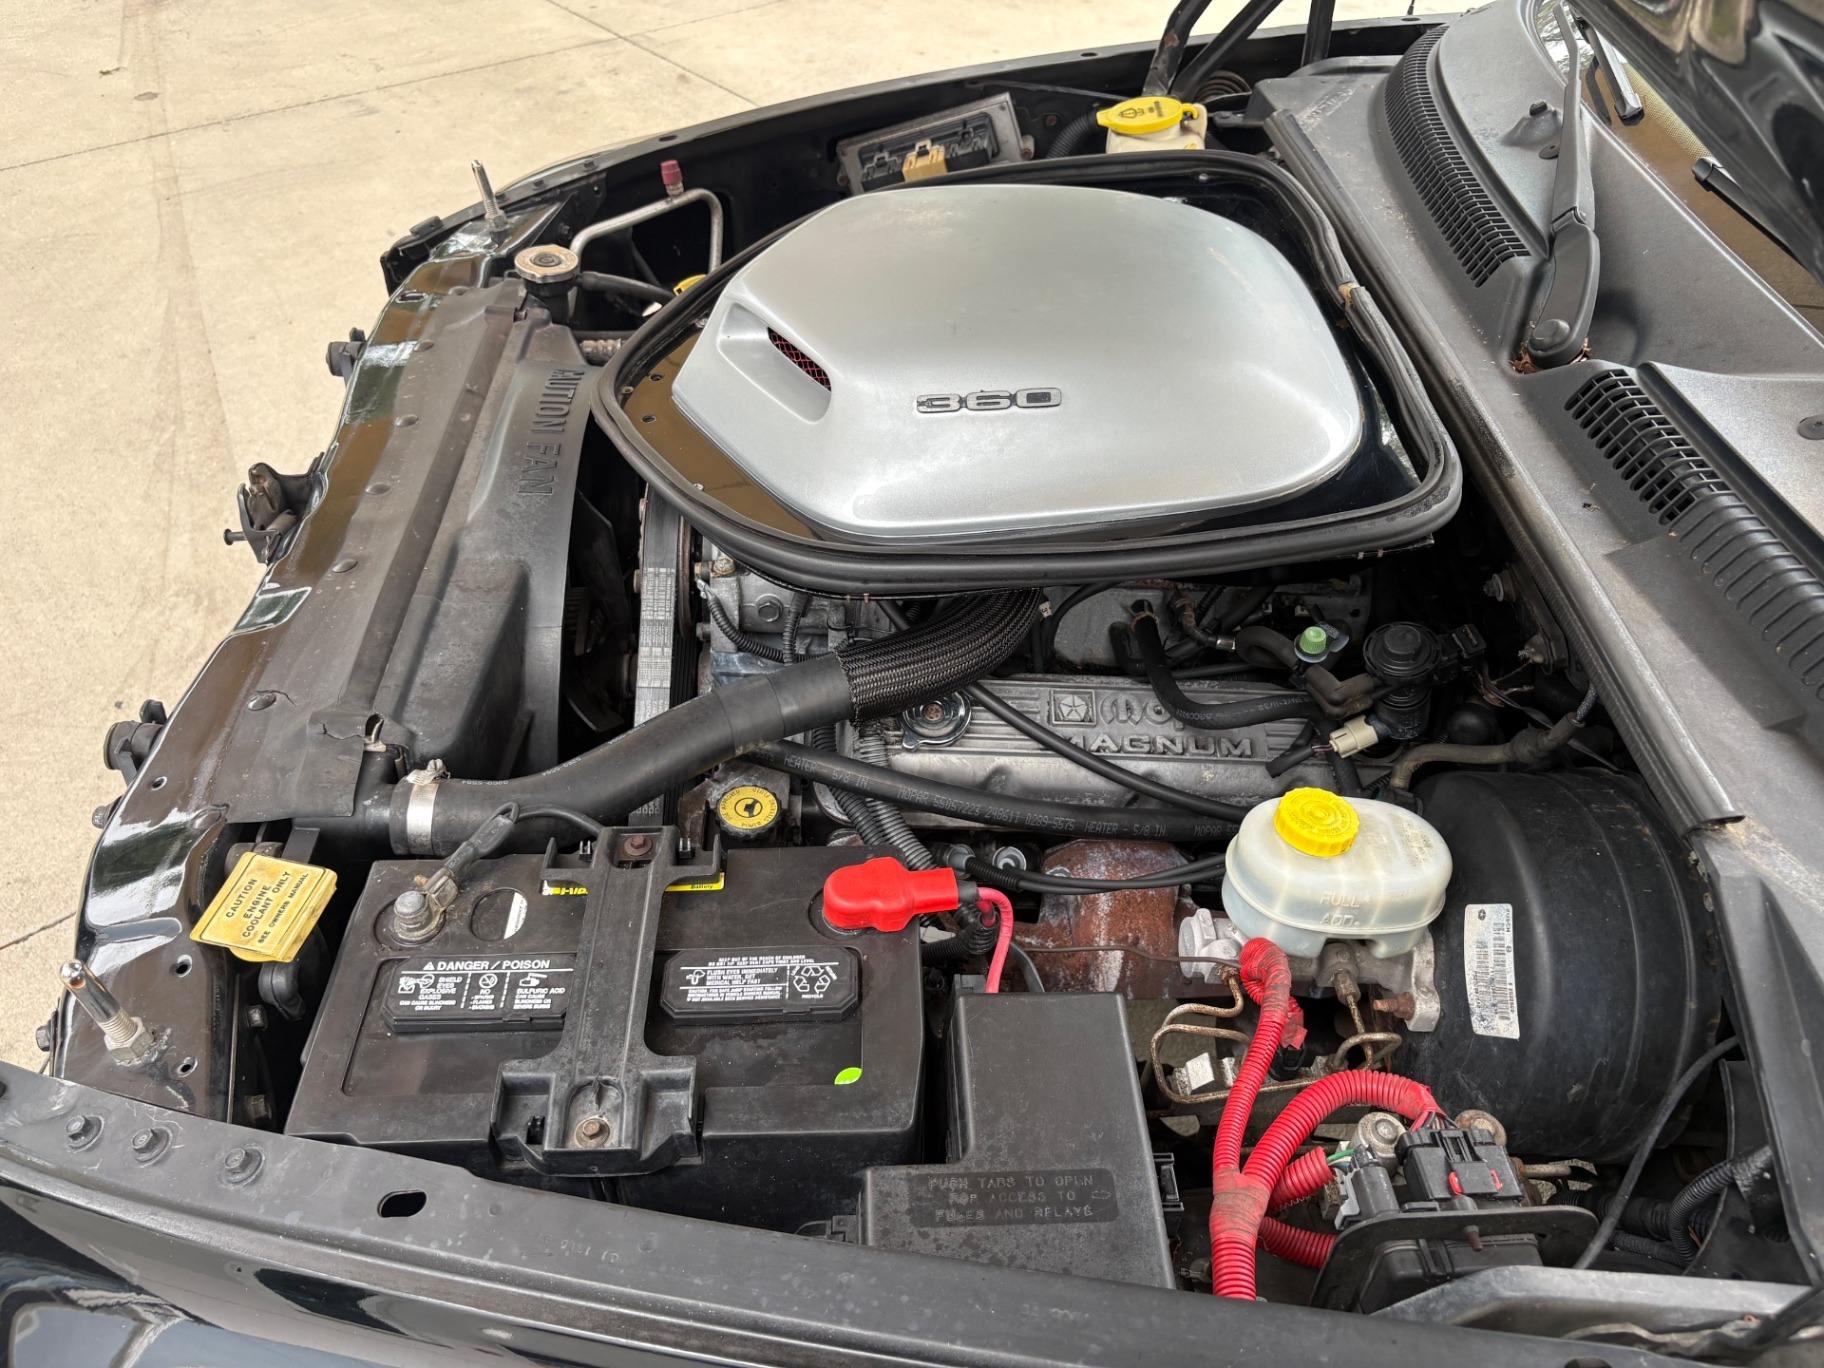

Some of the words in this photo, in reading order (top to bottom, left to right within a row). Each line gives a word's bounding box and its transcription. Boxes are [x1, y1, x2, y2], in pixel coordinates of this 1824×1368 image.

[531, 369, 585, 433] CAUTION
[916, 387, 1062, 413] 360
[518, 441, 561, 496] FAN
[784, 753, 817, 773] HEATER
[832, 769, 850, 782] 5/8
[897, 787, 929, 804] MOPAR
[933, 795, 981, 816] 55057223
[1024, 814, 1076, 831] 0289-5575
[1084, 822, 1118, 835] HEATER
[1133, 825, 1150, 836] 5/8
[226, 878, 257, 918] CAUTION
[242, 897, 273, 938] COOLANT
[271, 871, 291, 894] ONLY
[243, 884, 271, 919] ENGINE
[257, 930, 271, 944] SEE
[269, 900, 290, 928] OWNERS
[289, 872, 309, 899] MANUAL
[1319, 890, 1360, 907] FULL
[437, 960, 489, 970] DANGER
[502, 960, 550, 969] POISON
[928, 1177, 968, 1190] PUSH
[979, 1176, 1016, 1189] TABS
[1026, 1175, 1045, 1187] TO
[1054, 1175, 1093, 1187] OPEN
[990, 1191, 1046, 1203] ACCESS
[1059, 1191, 1076, 1201] TO
[995, 1208, 1023, 1219] AND
[1034, 1204, 1093, 1218] RELAYS
